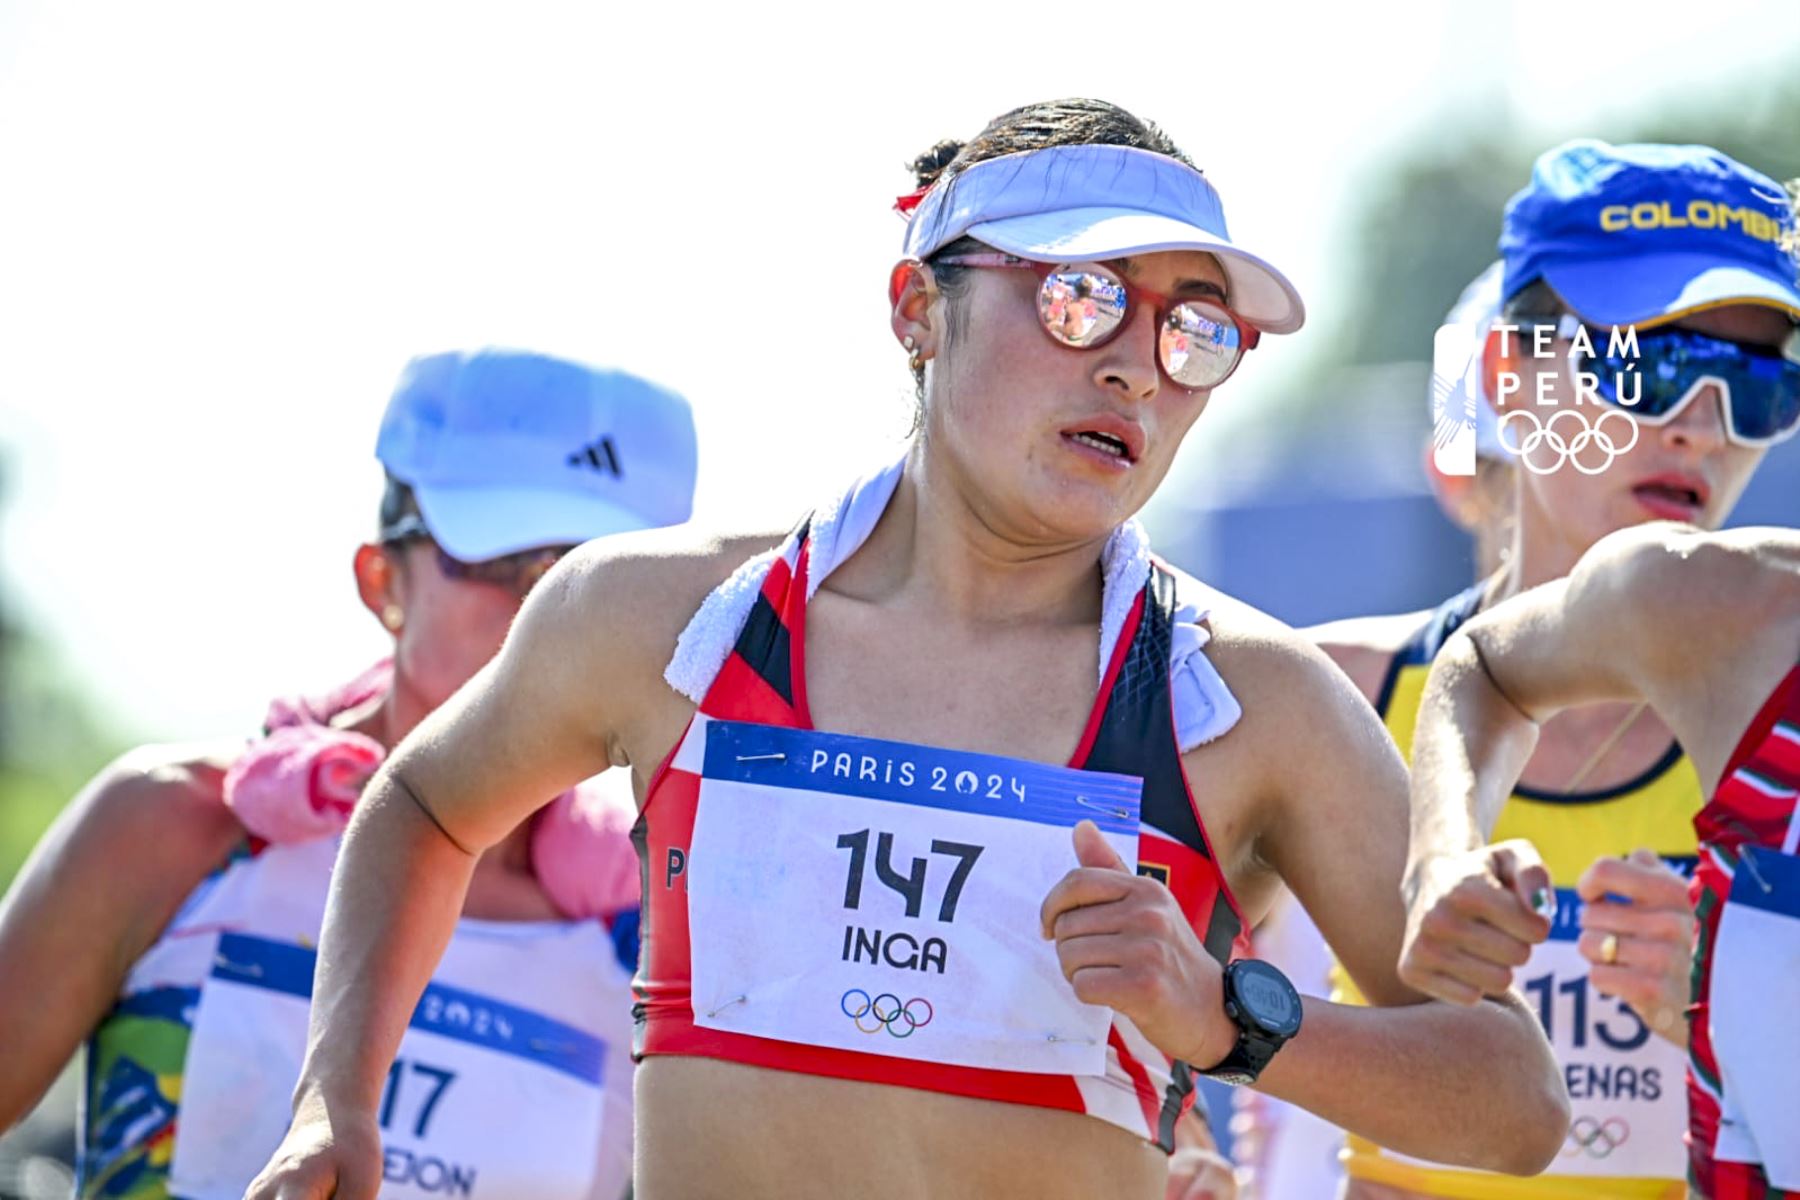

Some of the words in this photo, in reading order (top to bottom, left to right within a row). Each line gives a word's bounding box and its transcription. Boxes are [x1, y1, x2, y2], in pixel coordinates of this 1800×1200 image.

[930, 767, 1026, 802] 2024
[836, 828, 985, 923] 147
[842, 925, 948, 974] INGA
[1525, 972, 1652, 1050] 113
